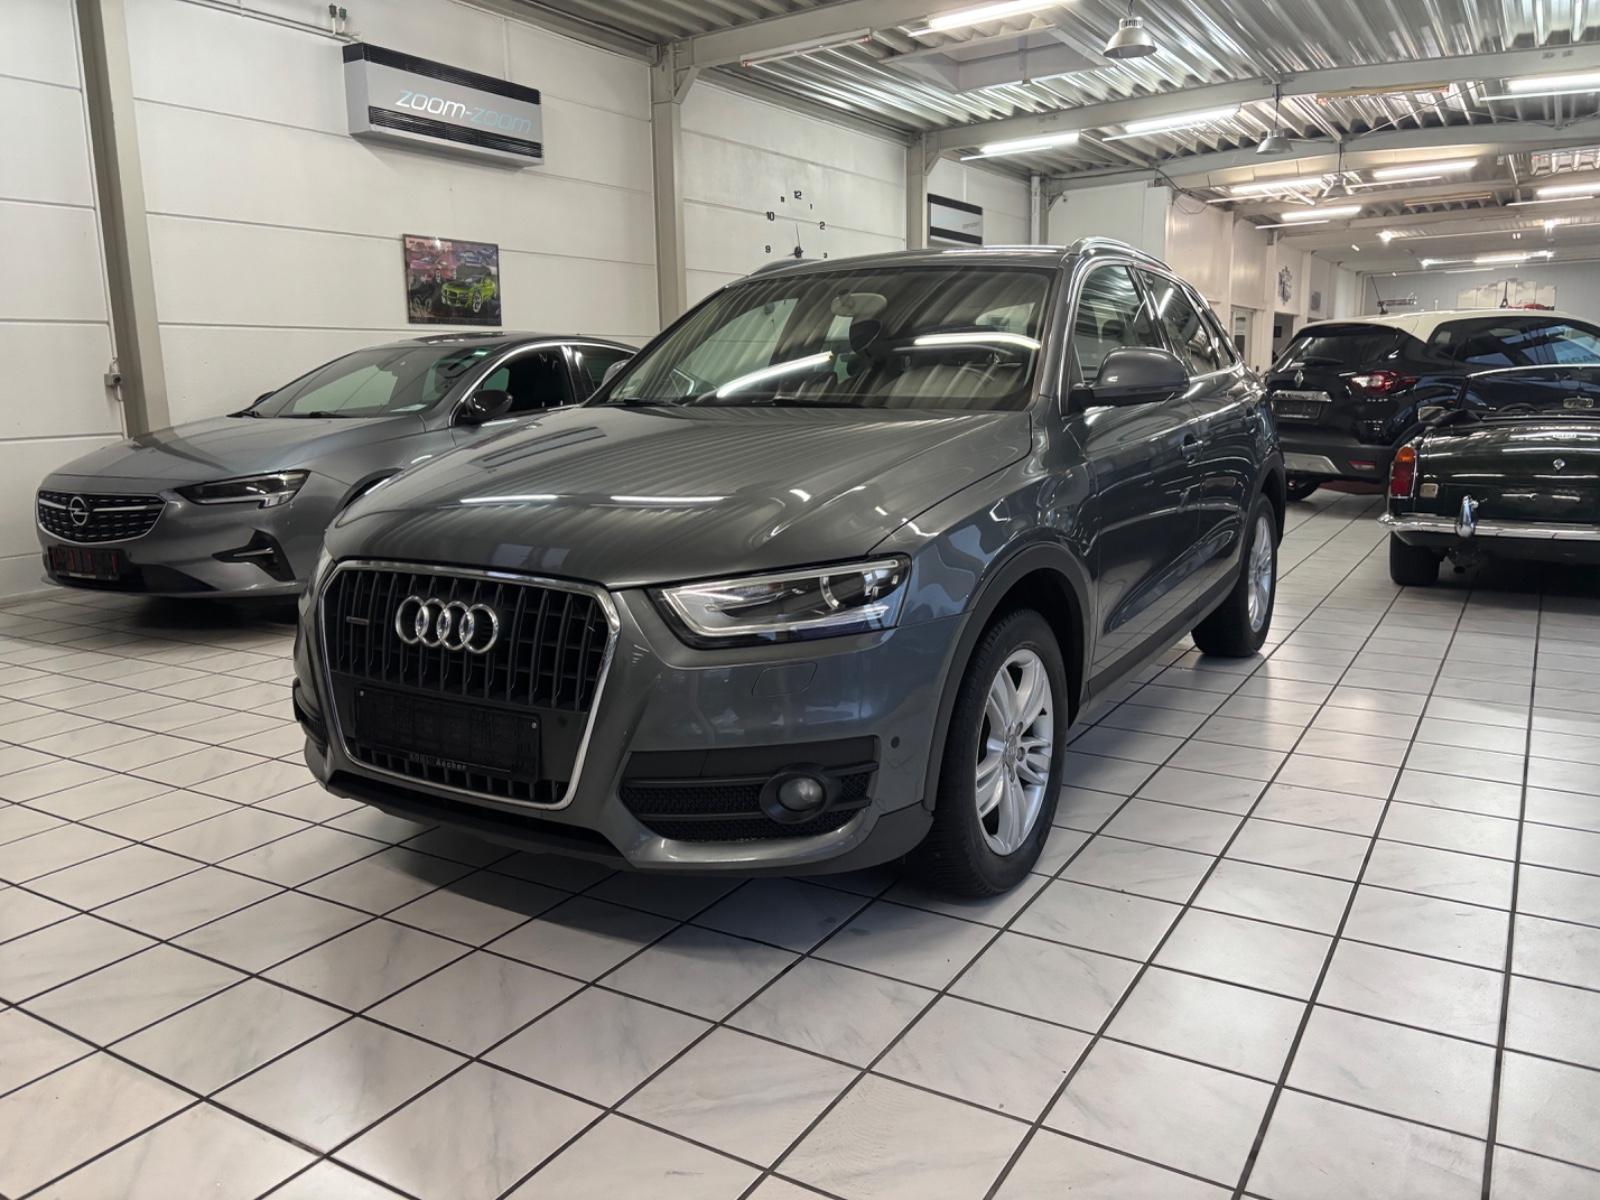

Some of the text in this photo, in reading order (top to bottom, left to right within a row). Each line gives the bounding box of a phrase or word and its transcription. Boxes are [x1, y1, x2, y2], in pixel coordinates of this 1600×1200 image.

[395, 90, 533, 134] zoom-zoom
[793, 190, 802, 200] 12
[766, 211, 775, 221] 10
[819, 221, 826, 230] 2
[765, 245, 771, 253] 9
